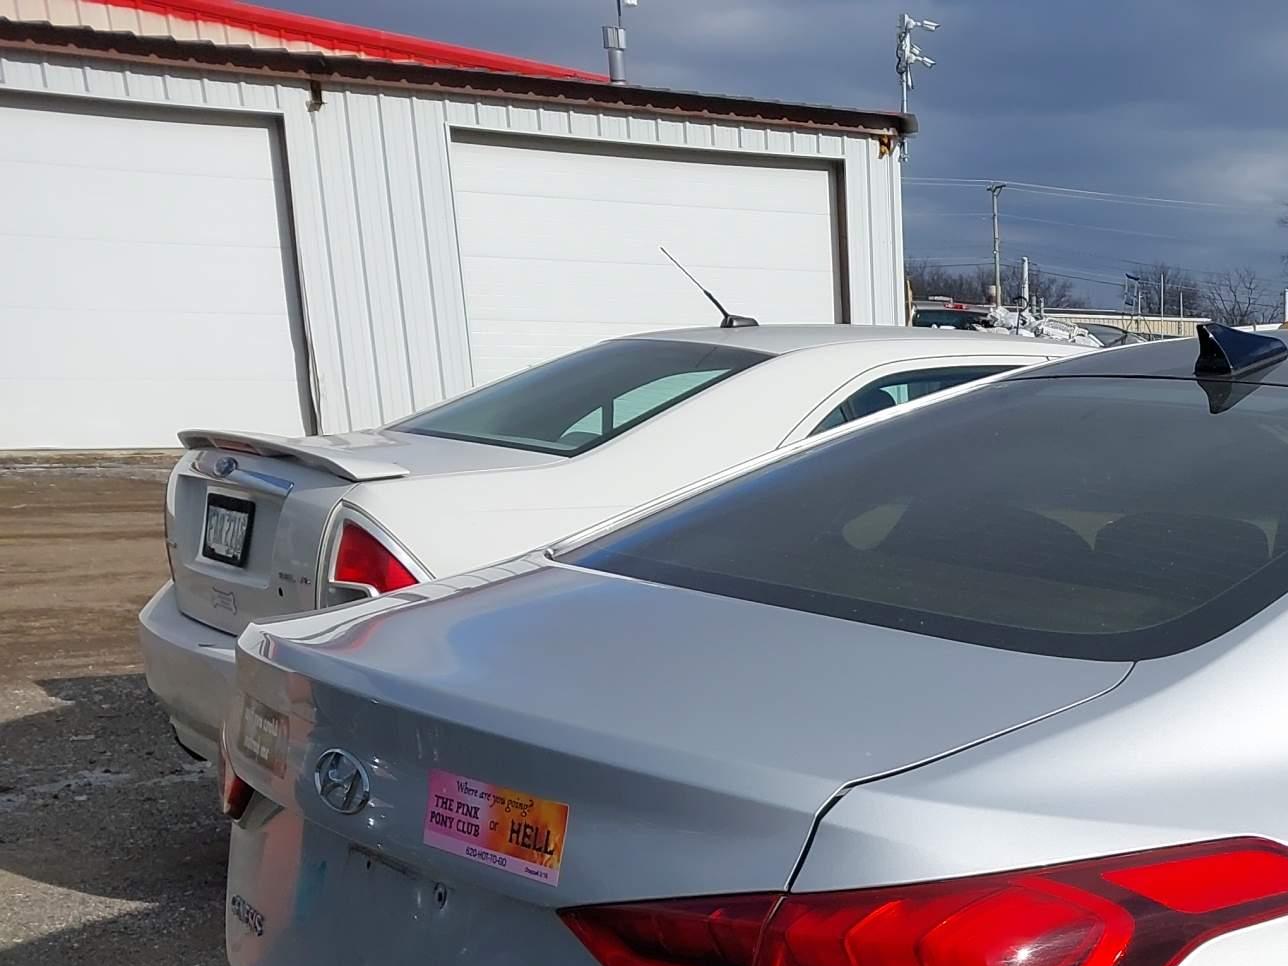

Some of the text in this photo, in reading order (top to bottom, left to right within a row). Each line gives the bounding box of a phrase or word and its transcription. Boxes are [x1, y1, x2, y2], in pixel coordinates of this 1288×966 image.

[434, 794, 481, 820] THE PINK
[456, 780, 534, 818] Where are you going?
[430, 811, 481, 838] PONY CLUB
[489, 820, 499, 831] or
[508, 819, 554, 856] HELL
